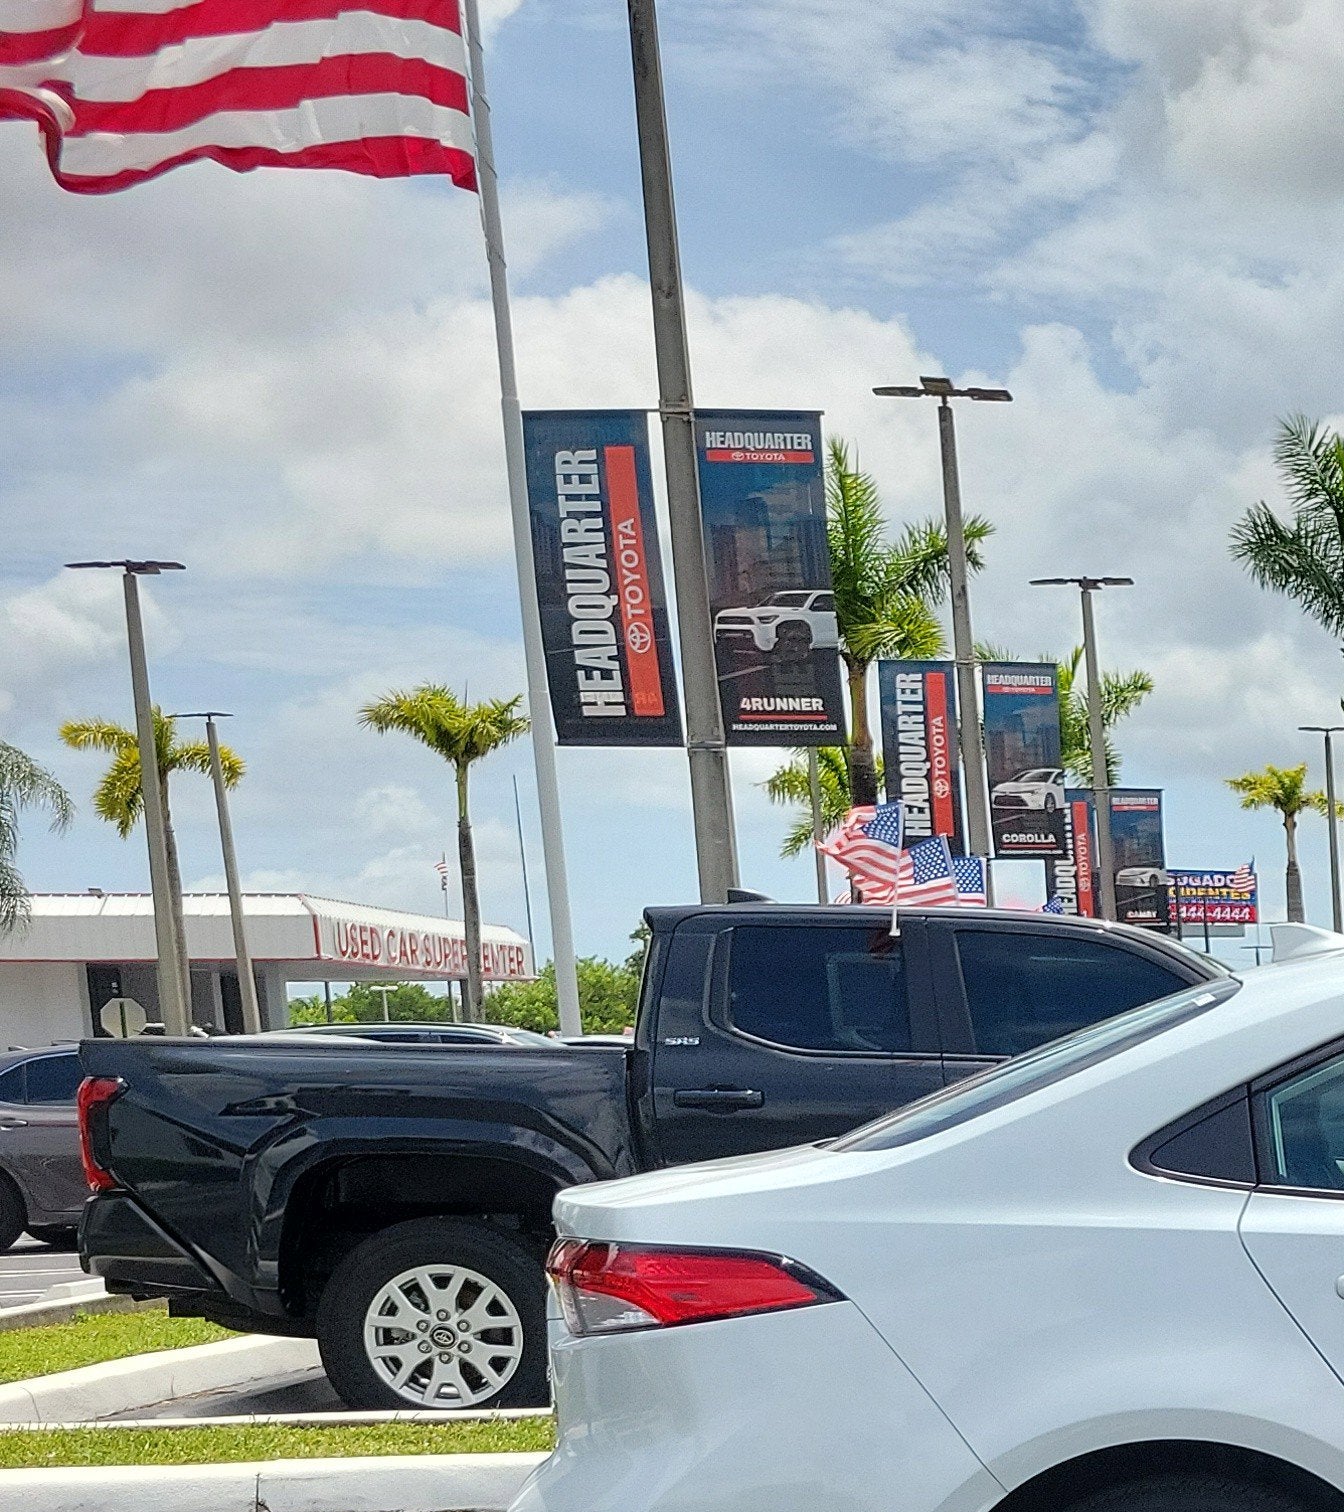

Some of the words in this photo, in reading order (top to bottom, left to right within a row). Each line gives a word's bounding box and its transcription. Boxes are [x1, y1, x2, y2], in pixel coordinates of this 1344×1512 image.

[705, 431, 813, 451] HEADQUARTER
[745, 451, 787, 461] TOYOTA
[554, 449, 628, 717] HEADQUARTER
[617, 517, 646, 619] TOYOTA
[740, 697, 825, 712] 4RUNNER
[895, 672, 933, 838] HEADQUARTER
[930, 715, 948, 781] TOYOTA
[1003, 833, 1056, 844] COROLLA
[335, 921, 382, 961] USED
[385, 929, 420, 966] CAR
[481, 942, 525, 976] ENTER
